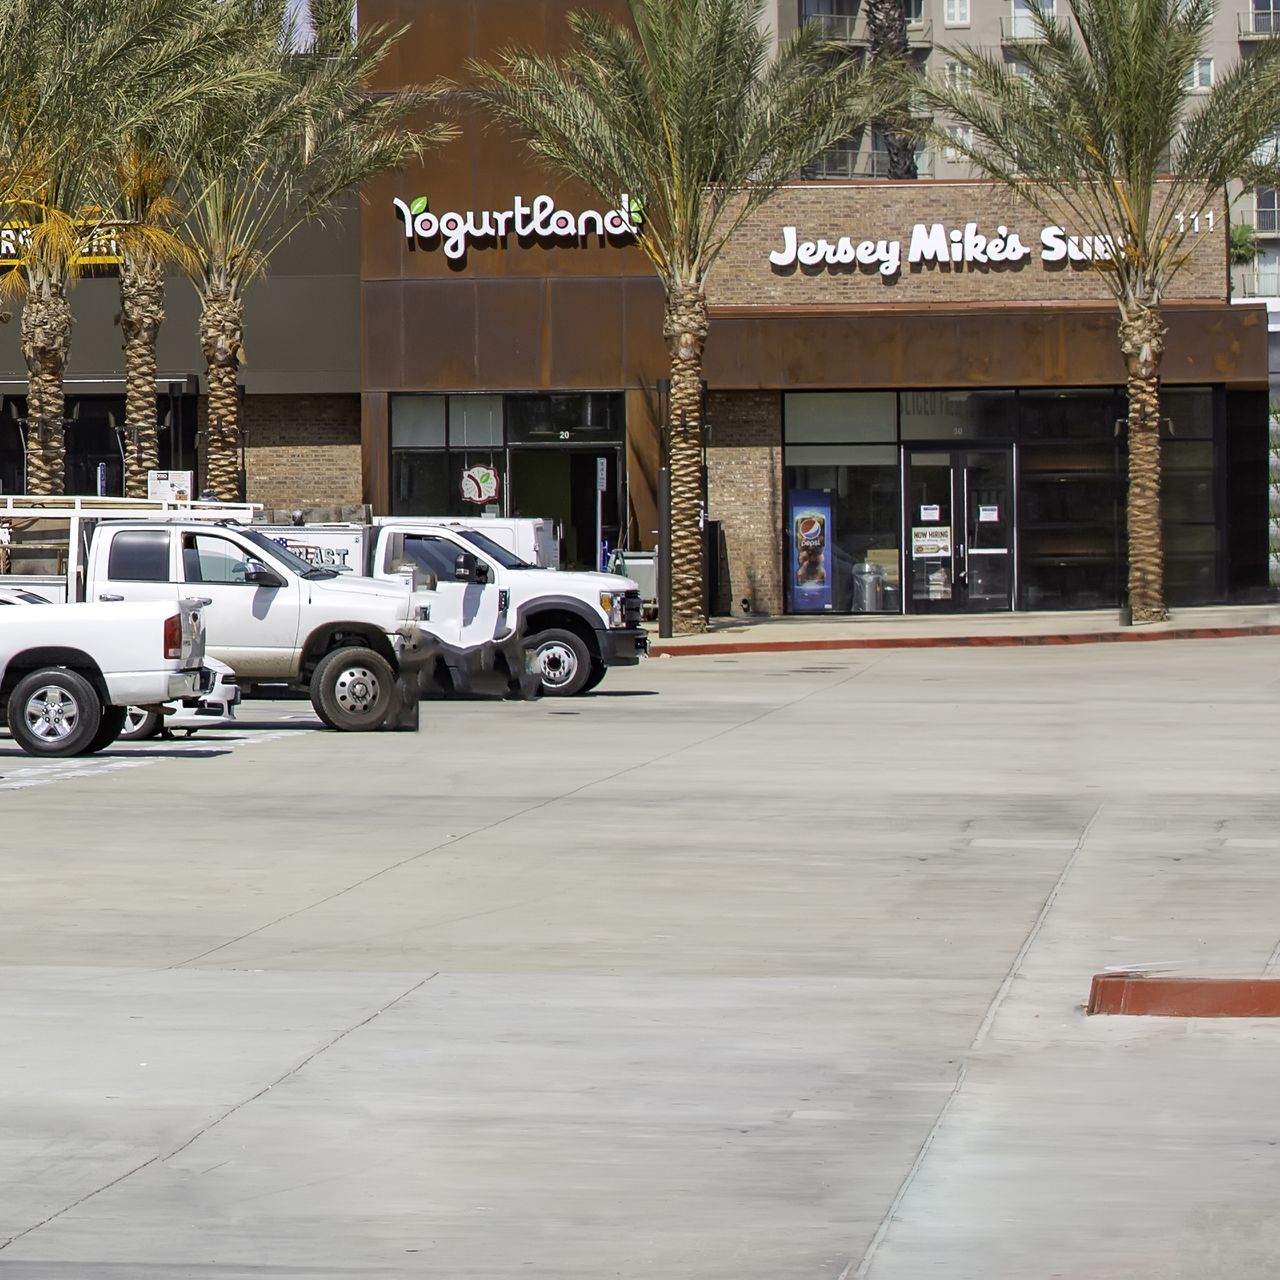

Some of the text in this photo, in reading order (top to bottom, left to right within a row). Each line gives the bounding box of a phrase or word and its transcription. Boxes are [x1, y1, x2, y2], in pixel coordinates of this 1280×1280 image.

[393, 193, 637, 259] Yogurtland
[1175, 210, 1214, 233] 111
[768, 226, 901, 275] Jersey
[908, 222, 1031, 264] Mike's
[559, 431, 570, 439] 20
[914, 530, 949, 538] NOW HIRING
